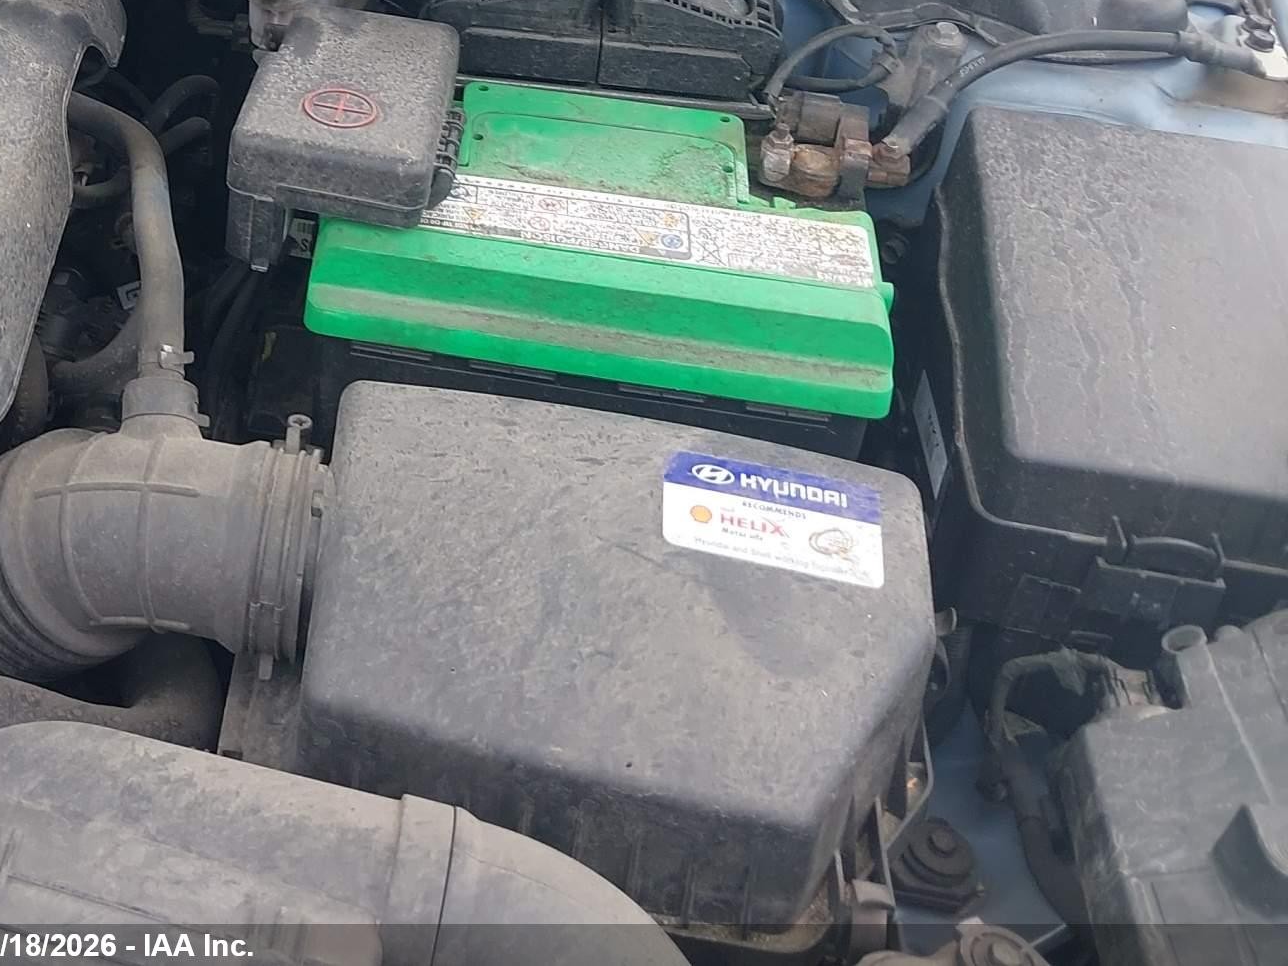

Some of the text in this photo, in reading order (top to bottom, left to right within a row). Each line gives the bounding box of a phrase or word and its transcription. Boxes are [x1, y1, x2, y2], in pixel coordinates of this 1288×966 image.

[740, 473, 848, 508] HYUNDAI
[742, 501, 807, 519] RECOMMENDS
[720, 514, 786, 537] HELIX
